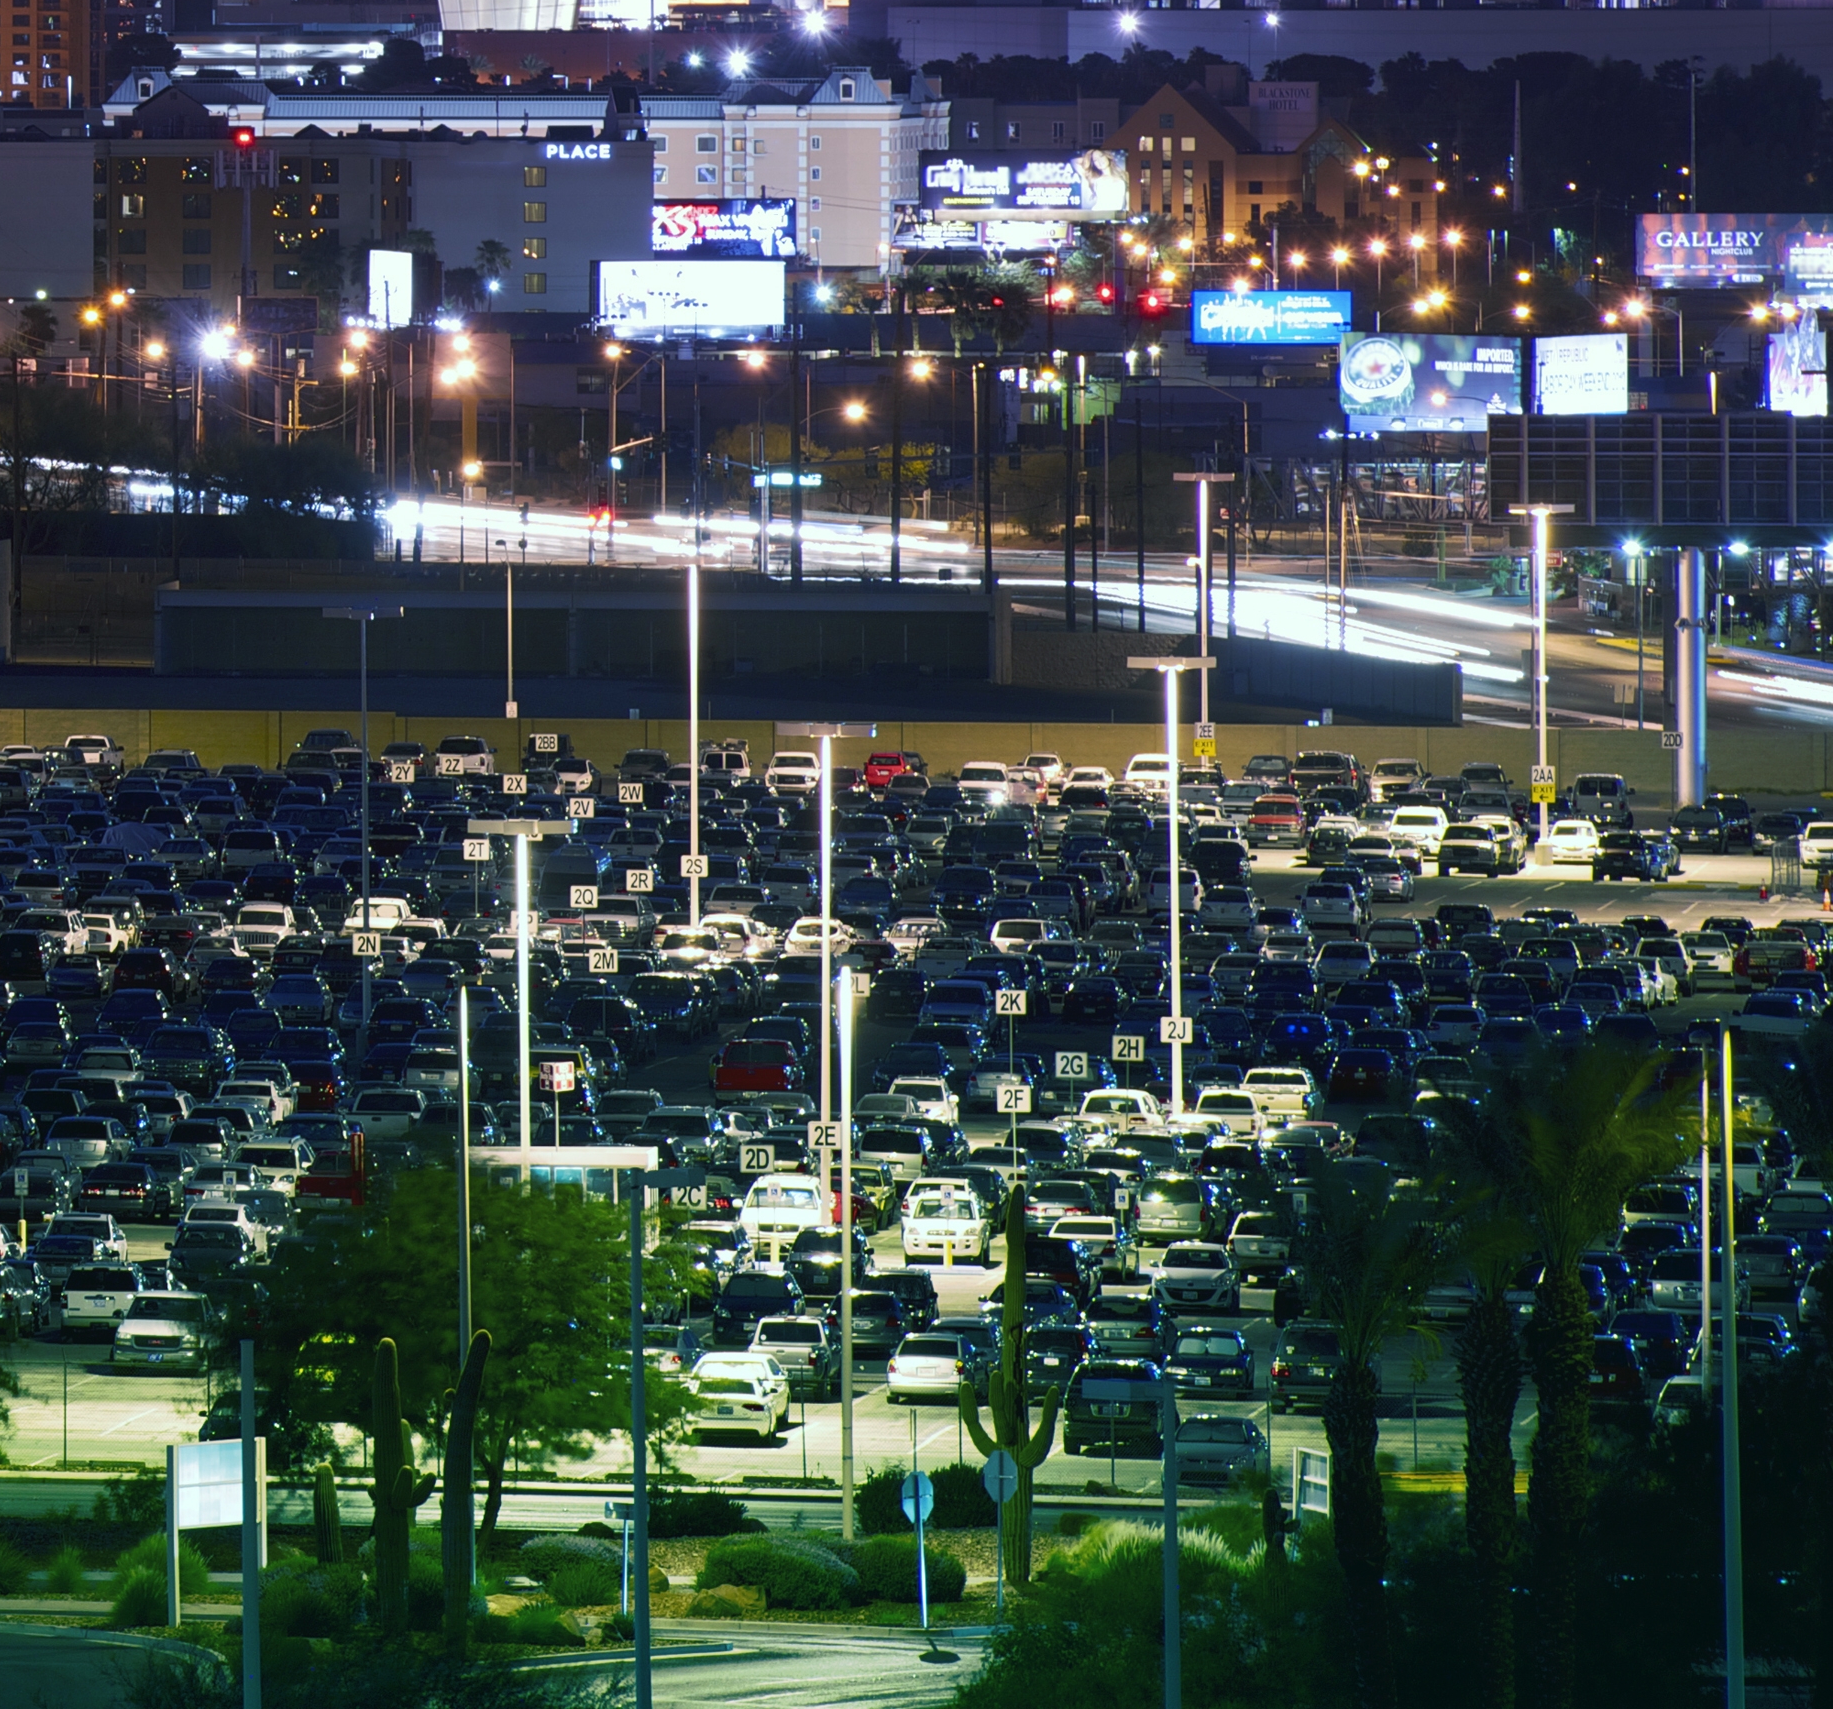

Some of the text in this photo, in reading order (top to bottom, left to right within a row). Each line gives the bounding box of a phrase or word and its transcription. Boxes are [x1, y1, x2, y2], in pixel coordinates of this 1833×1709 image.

[1259, 87, 1311, 99] BLACKSTONE
[1269, 99, 1300, 110] HOTEL
[546, 144, 611, 159] PLACE
[1656, 231, 1764, 248] GALLERY
[1711, 248, 1754, 256] NIGHTCLUB
[1199, 725, 1212, 737] 2EE
[538, 736, 556, 750] 2BB
[1664, 733, 1681, 747] 2DD
[395, 766, 411, 780] 2Y
[445, 759, 460, 772] 2Z
[1533, 768, 1553, 782] 2AA
[507, 777, 523, 791] 2X
[621, 786, 641, 800] 2W
[574, 800, 590, 815] 2V
[468, 842, 485, 857] 2T
[686, 858, 703, 874] 2S
[630, 873, 648, 888] 2R
[574, 888, 594, 905] 2Q
[357, 936, 376, 953] 2N
[593, 952, 614, 969] 2M
[1000, 993, 1021, 1011] 2K
[1168, 1021, 1186, 1040] 2J
[1117, 1038, 1139, 1058] 2H
[1060, 1055, 1083, 1075] 2G
[1004, 1089, 1024, 1109] 2F
[814, 1126, 836, 1146] 2E
[745, 1148, 769, 1169] 2D
[675, 1186, 700, 1207] 2C
